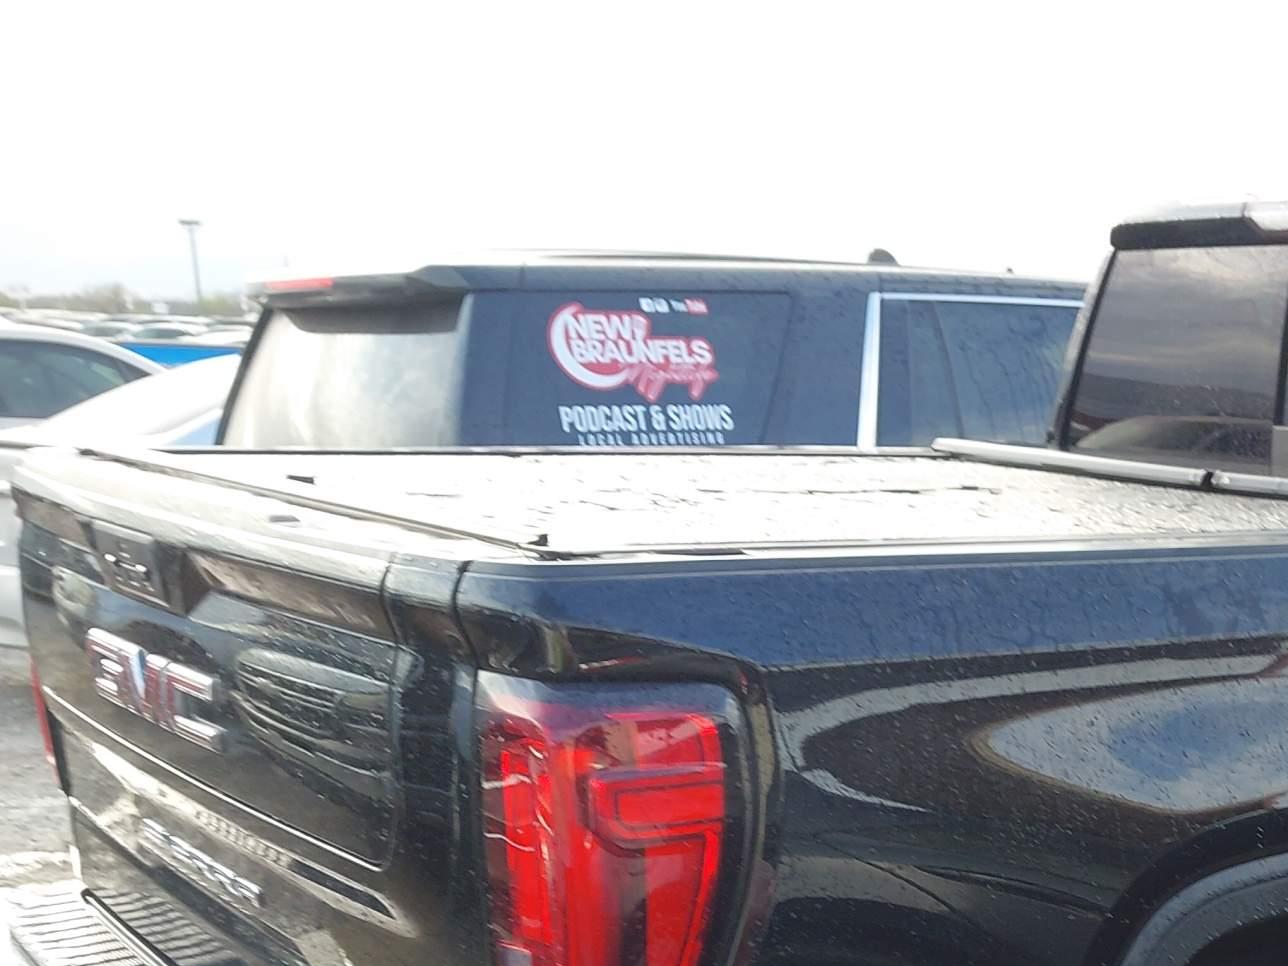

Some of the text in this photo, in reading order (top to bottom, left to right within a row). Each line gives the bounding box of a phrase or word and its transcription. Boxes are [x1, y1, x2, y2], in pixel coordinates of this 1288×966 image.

[561, 313, 631, 341] NEW
[570, 338, 713, 365] BRAUNFELS
[558, 403, 735, 433] PODCAST & SHOWS
